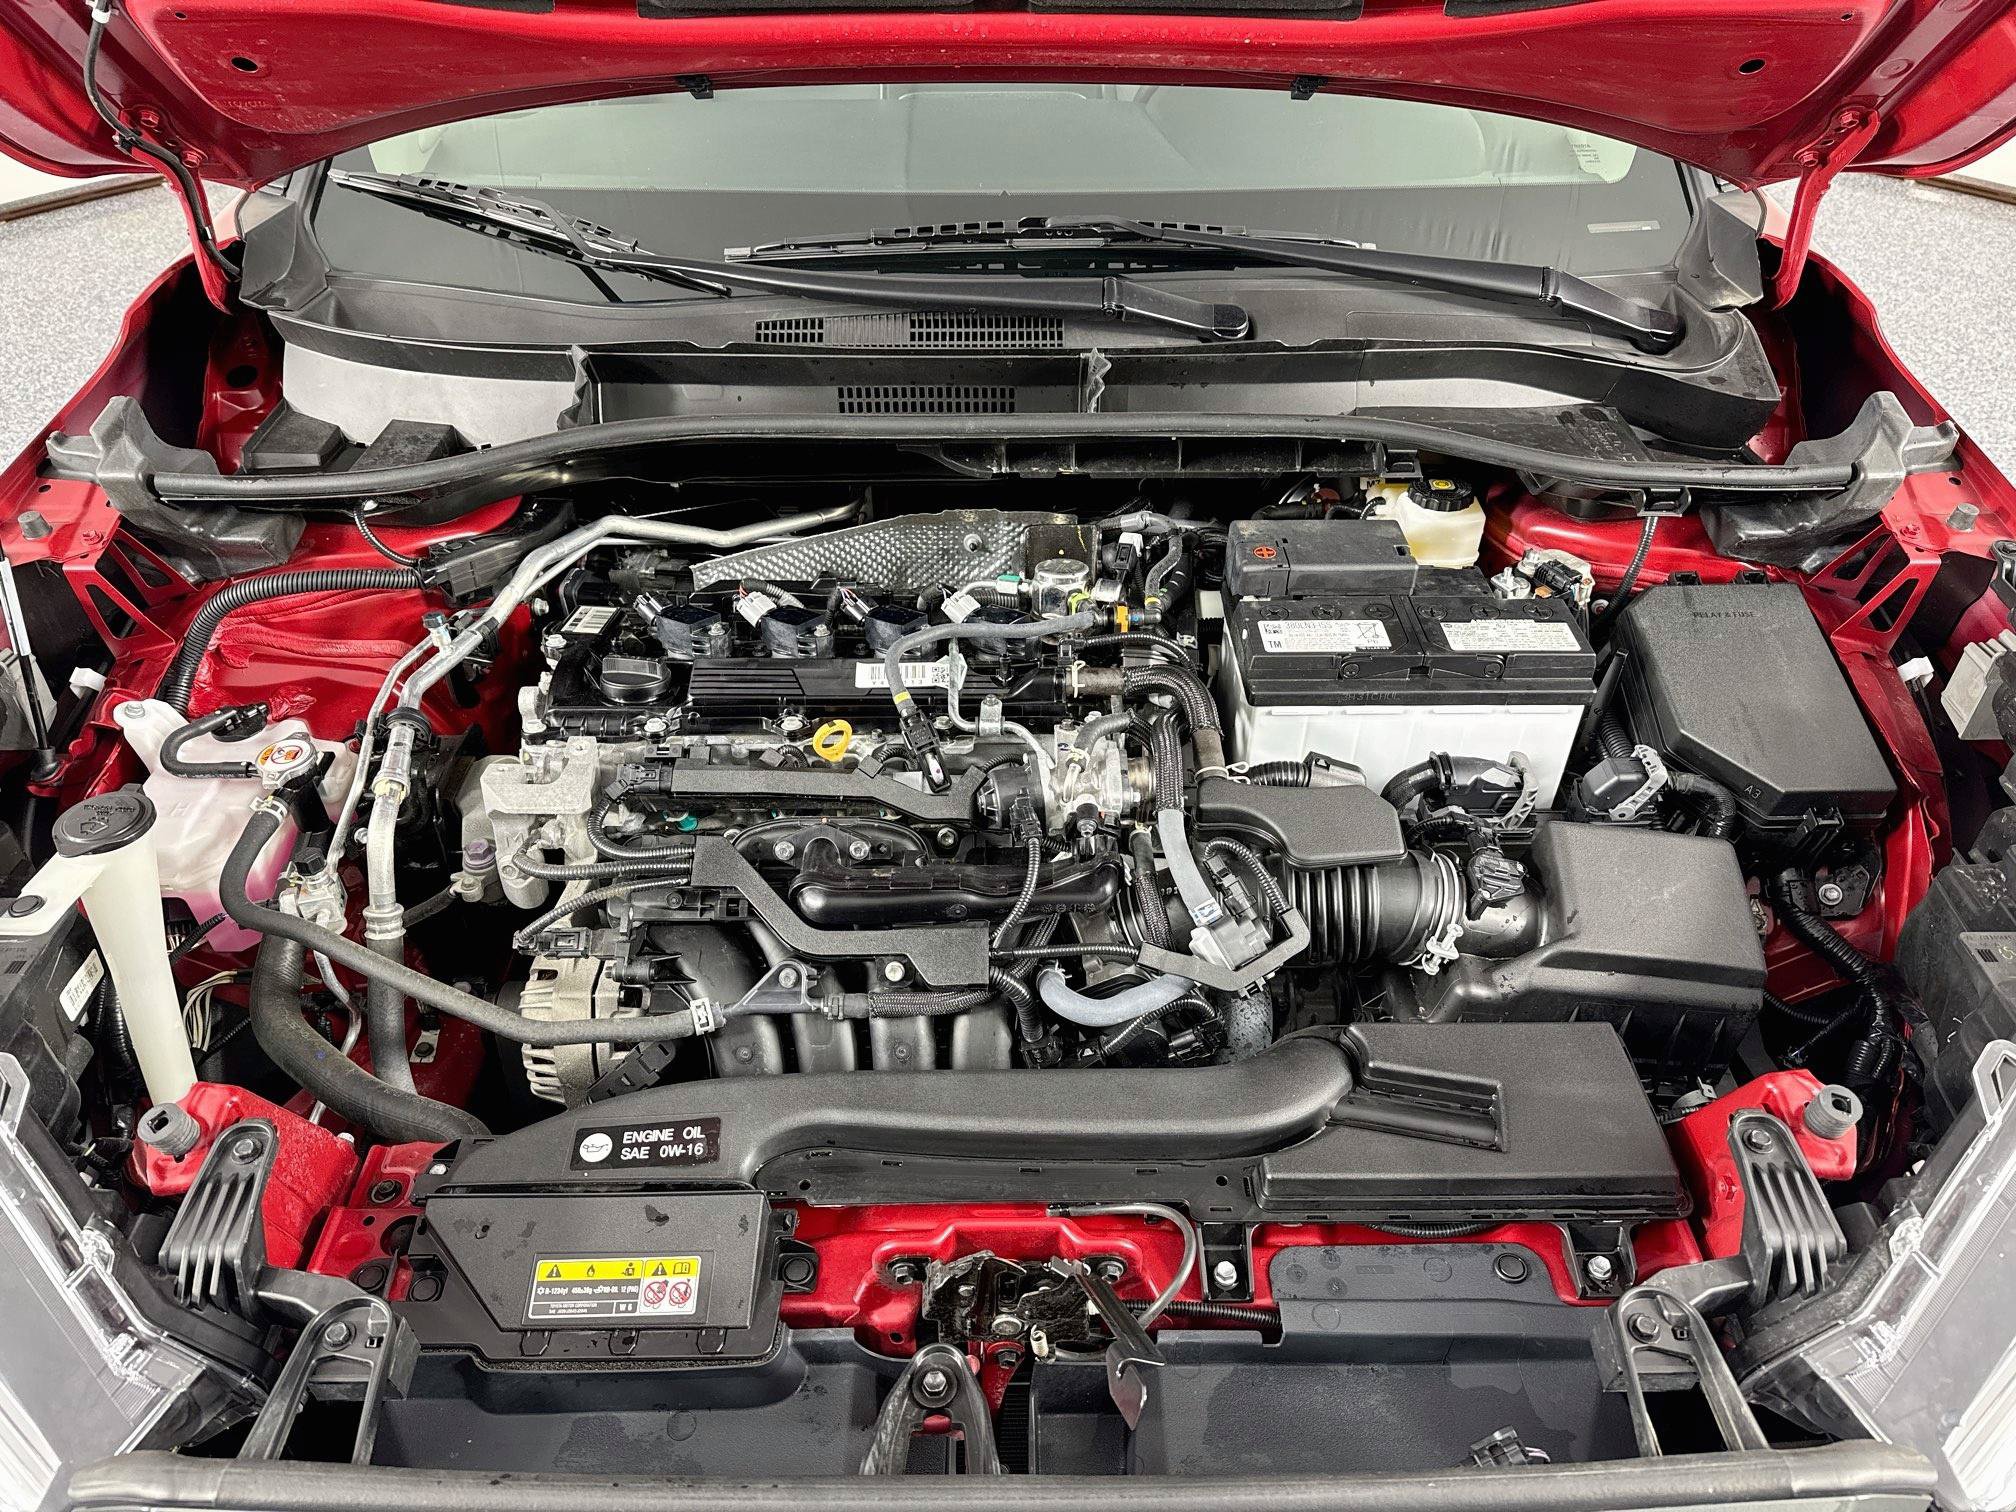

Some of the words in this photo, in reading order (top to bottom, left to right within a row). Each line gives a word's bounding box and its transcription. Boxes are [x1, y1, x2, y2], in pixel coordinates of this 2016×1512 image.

[1267, 640, 1283, 649] TM
[1743, 785, 1762, 799] A3
[622, 1128, 674, 1144] ENGINE
[682, 1126, 706, 1140] OIL
[620, 1146, 650, 1161] SAE
[659, 1143, 704, 1159] 0W-16
[619, 1303, 627, 1311] W
